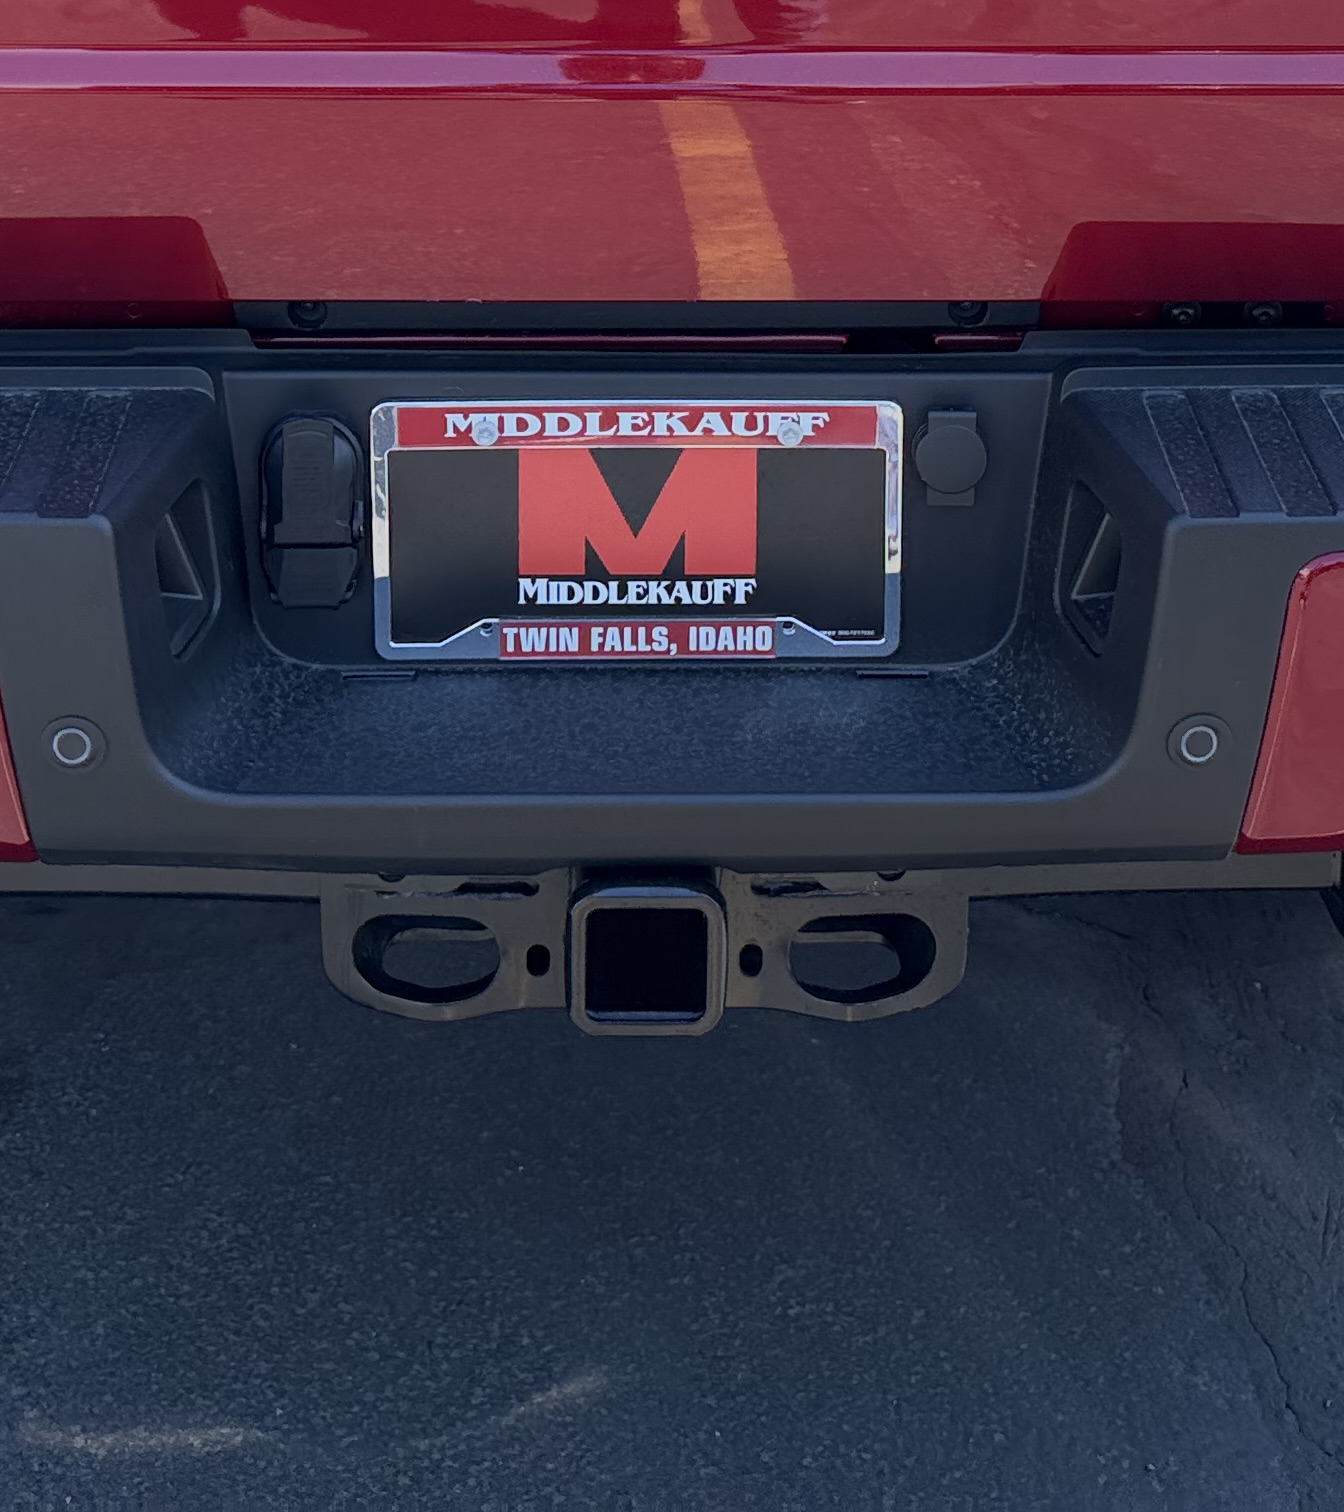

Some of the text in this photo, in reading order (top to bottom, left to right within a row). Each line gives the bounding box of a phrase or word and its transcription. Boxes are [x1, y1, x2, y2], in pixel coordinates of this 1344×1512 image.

[517, 446, 758, 576] M
[517, 577, 757, 606] MIDDLEKAUFF
[501, 624, 774, 656] TWIN FALLS, IDAHO
